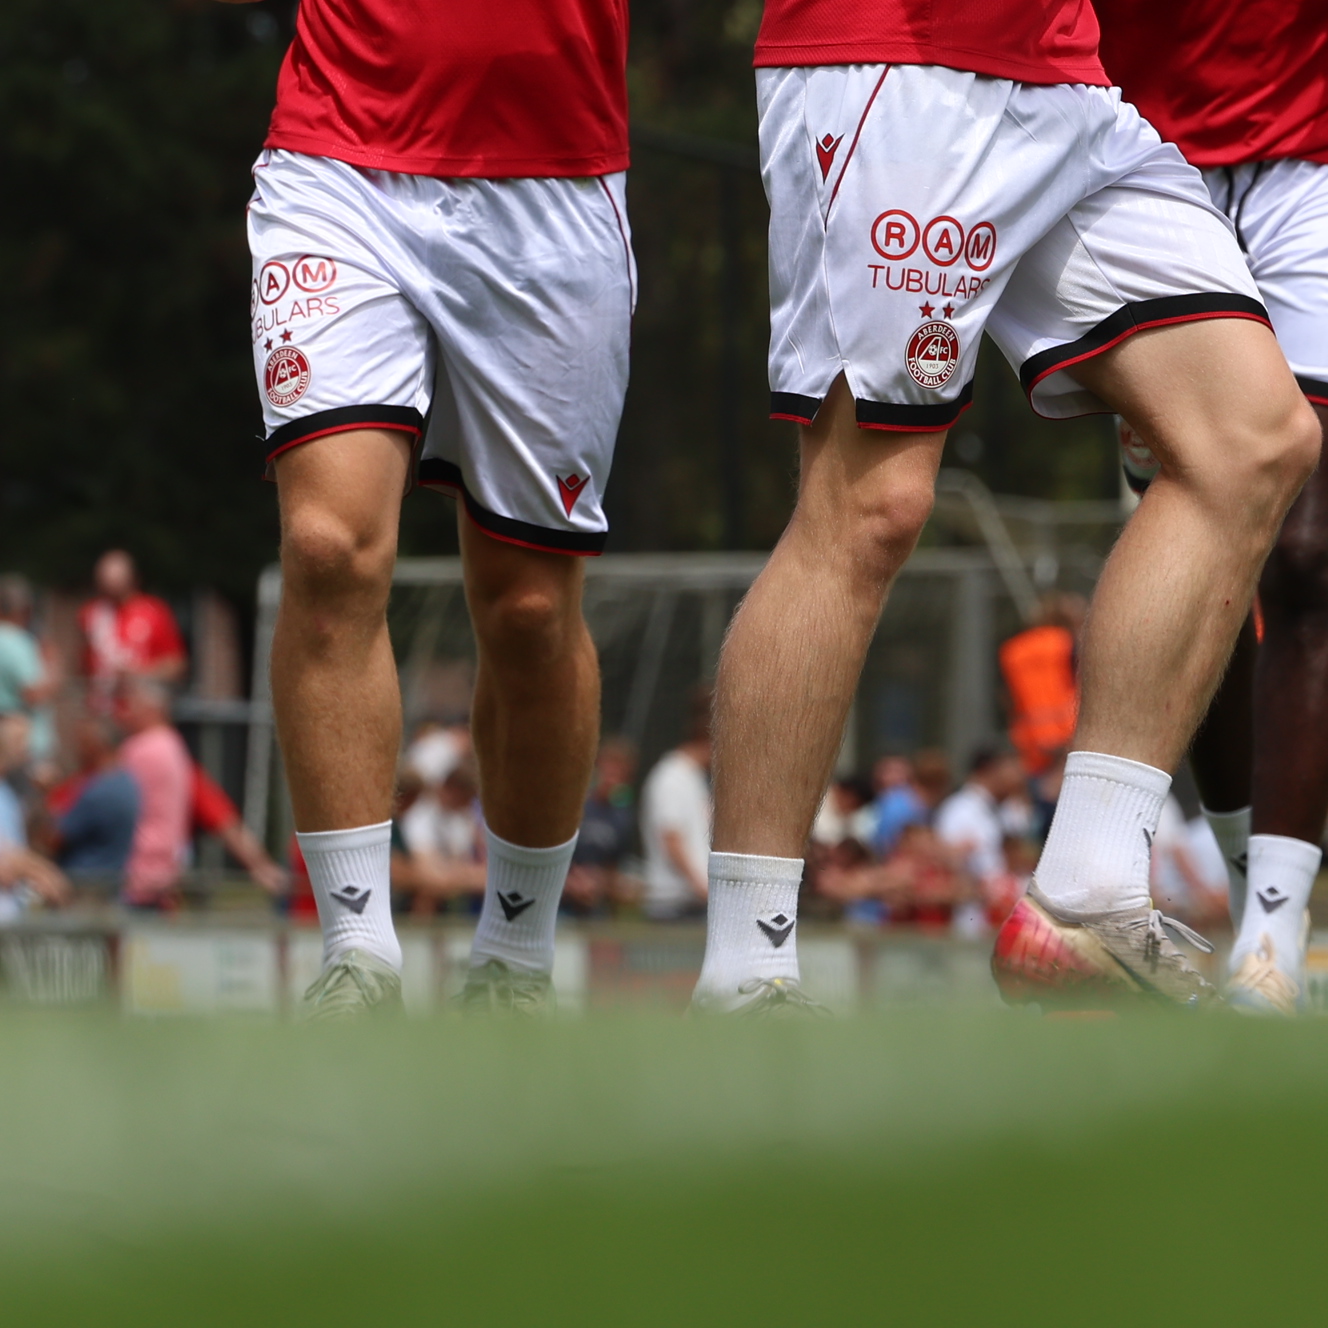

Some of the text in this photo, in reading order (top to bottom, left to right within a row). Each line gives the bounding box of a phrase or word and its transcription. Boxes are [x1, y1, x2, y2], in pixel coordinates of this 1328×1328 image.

[878, 215, 993, 265] RAM
[252, 296, 341, 345] BULARS
[917, 324, 956, 341] ABERDEEN
[268, 349, 299, 372] ABERDEEN
[908, 357, 957, 385] FOOTBALL CLUB
[267, 371, 308, 404] FOOTBALL CLUB
